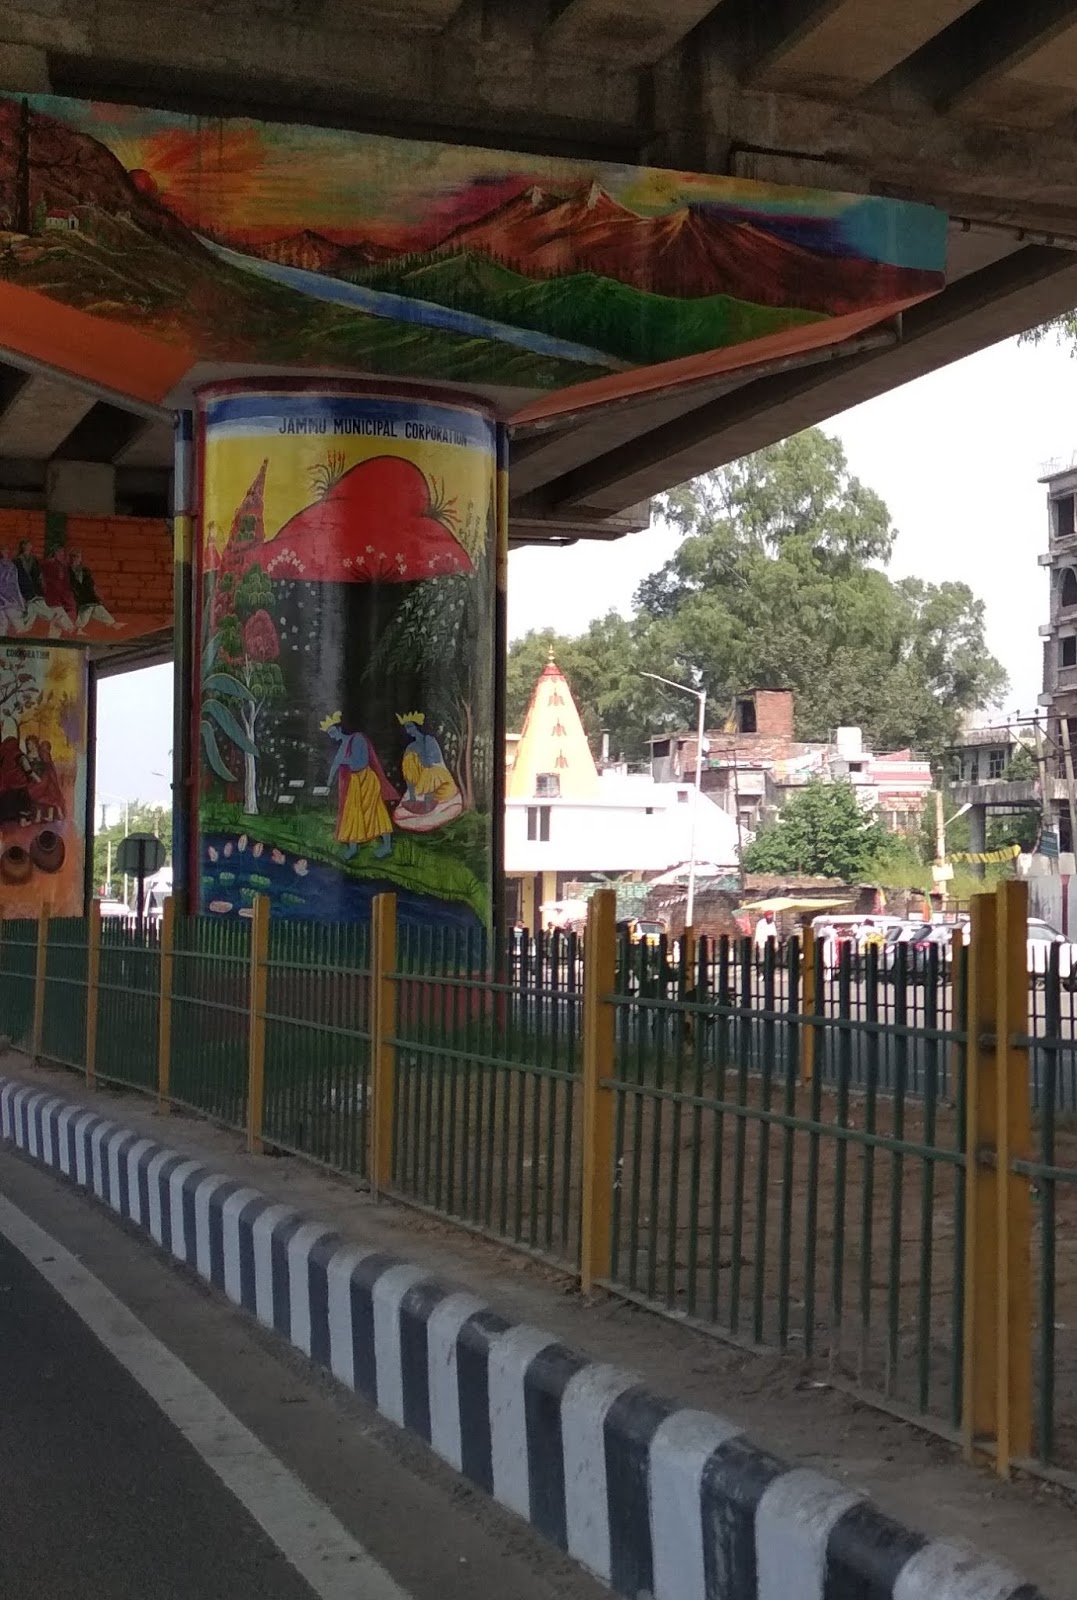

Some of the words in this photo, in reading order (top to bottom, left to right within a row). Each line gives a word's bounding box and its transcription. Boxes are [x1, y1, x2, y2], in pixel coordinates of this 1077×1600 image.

[279, 417, 327, 435] JAMMU
[333, 418, 398, 437] MUNICIPAL
[405, 422, 467, 446] CORPORATION
